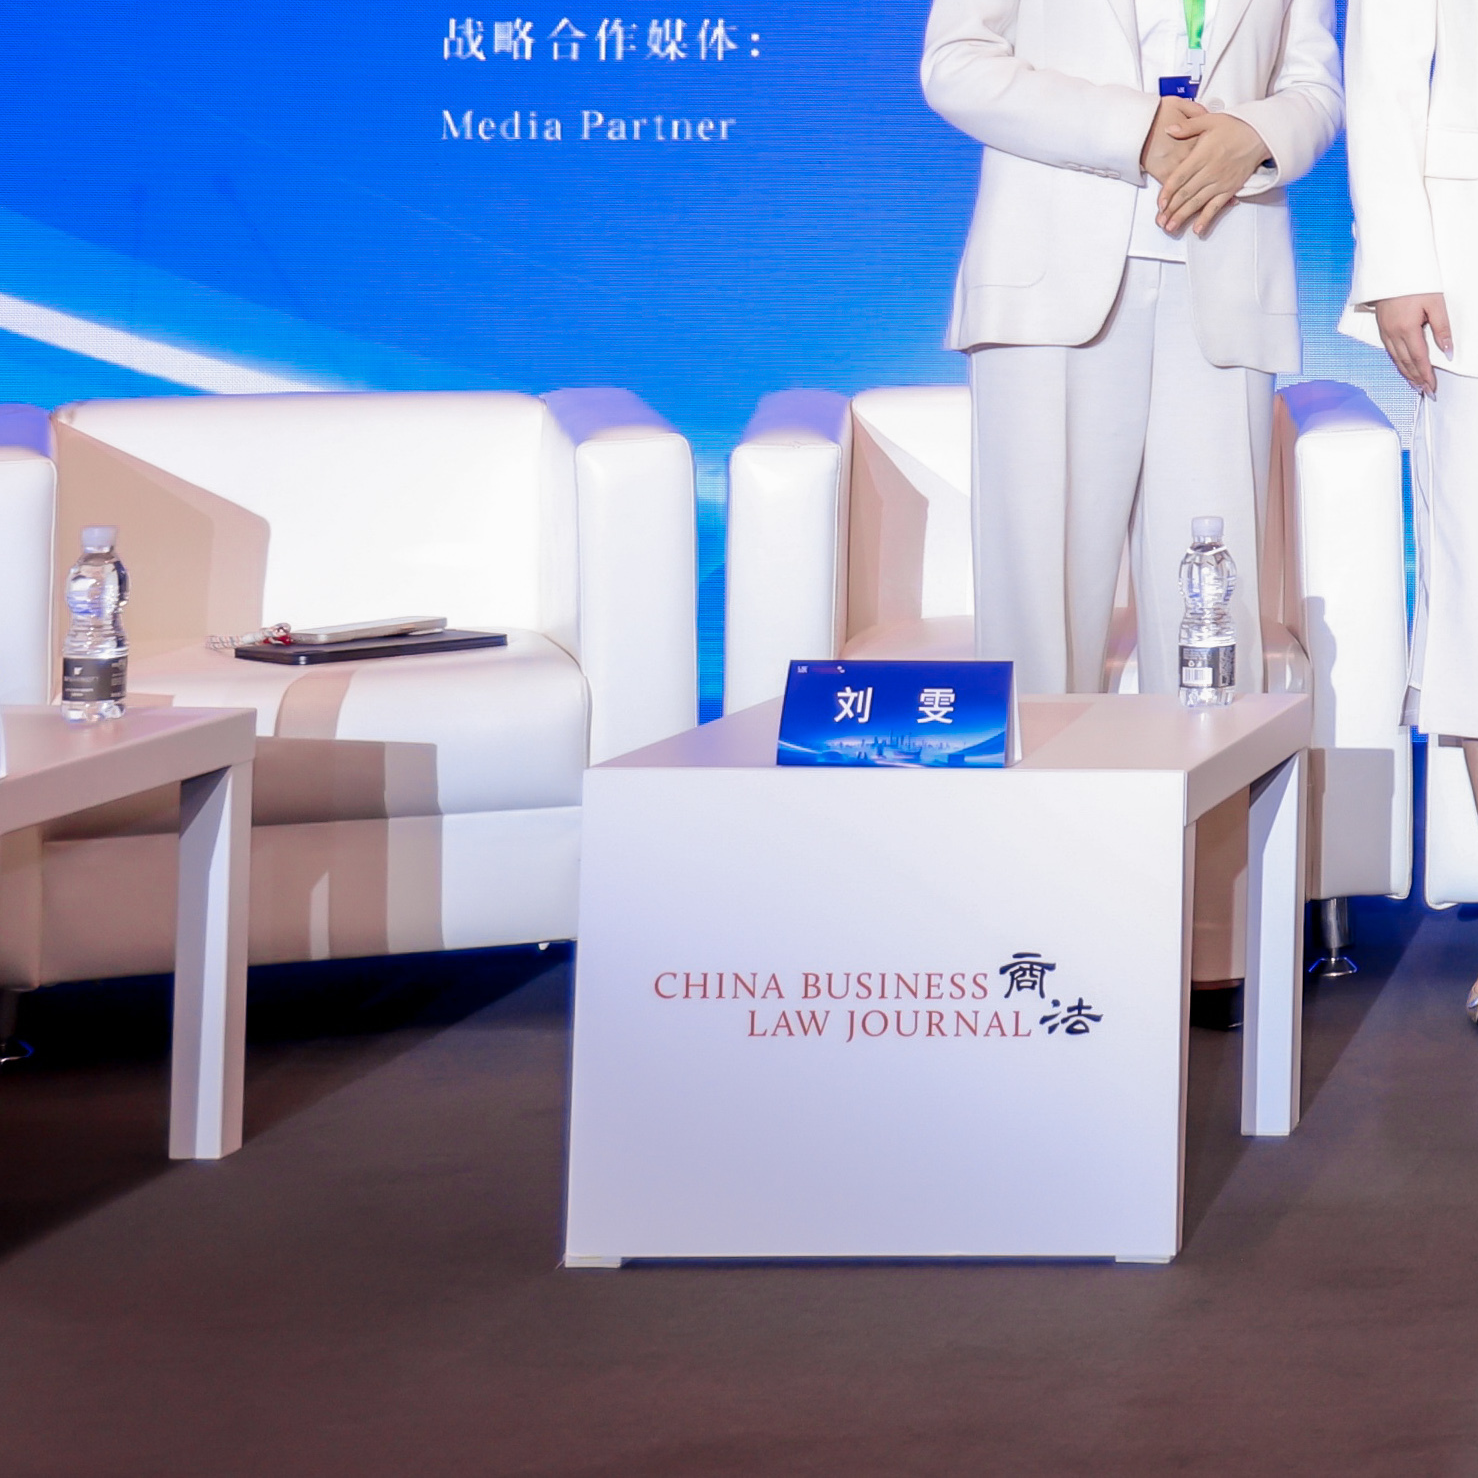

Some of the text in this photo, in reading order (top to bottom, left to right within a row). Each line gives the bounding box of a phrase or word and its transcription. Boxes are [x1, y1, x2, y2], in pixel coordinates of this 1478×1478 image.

[441, 109, 736, 142] Media Partner
[654, 972, 988, 1000] CHINA BUSINESS
[747, 1009, 1032, 1043] LAW JOURNAL
